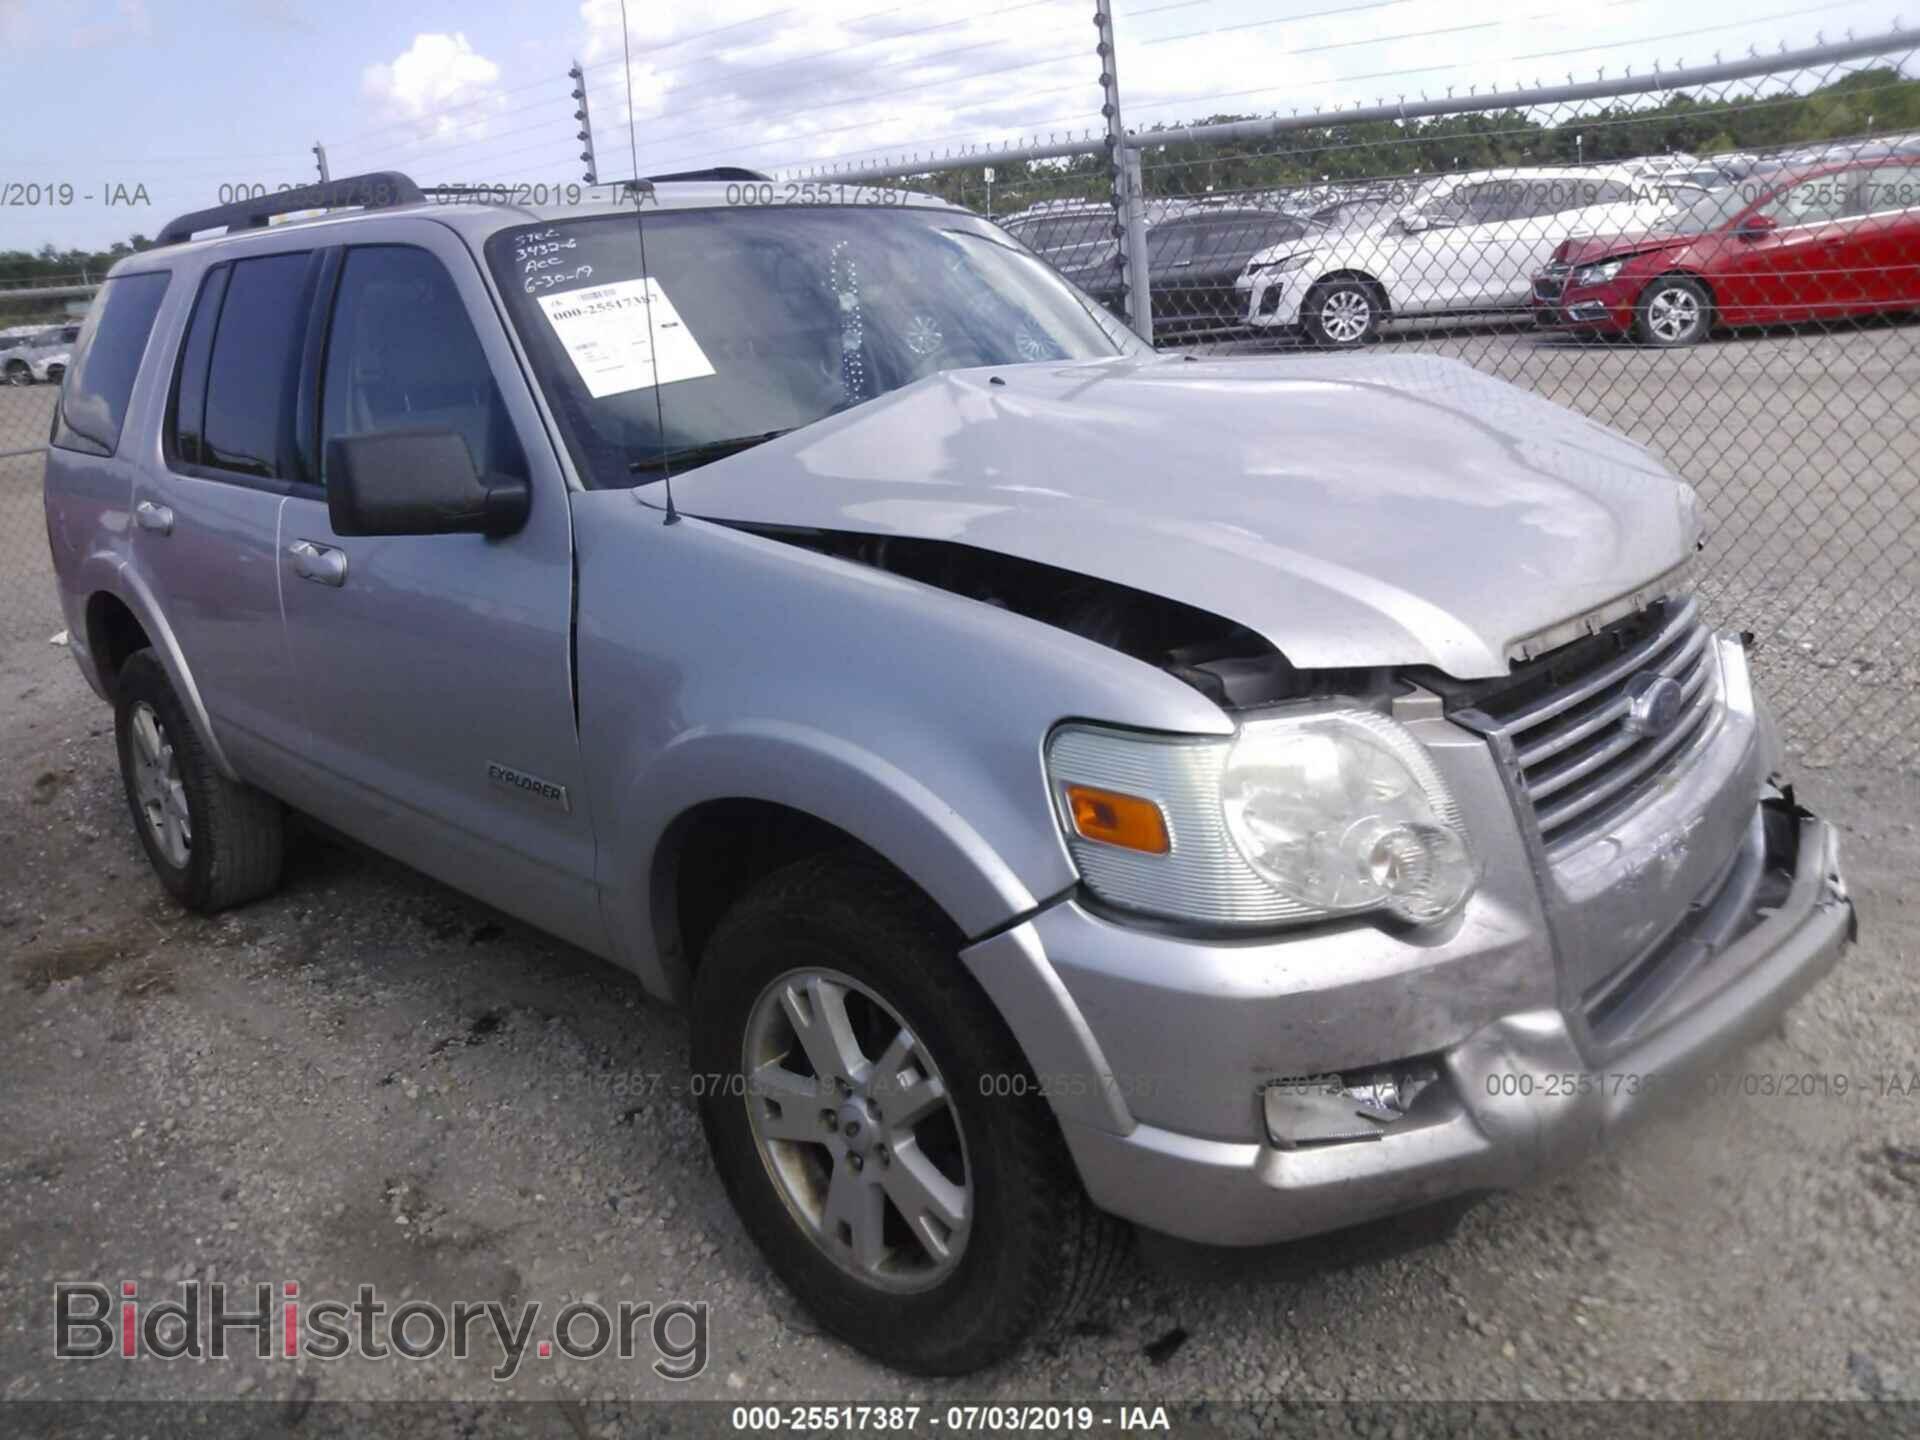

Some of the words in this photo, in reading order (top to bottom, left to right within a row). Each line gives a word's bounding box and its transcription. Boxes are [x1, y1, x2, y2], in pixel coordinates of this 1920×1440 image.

[524, 265, 593, 293] 6-30-19
[552, 294, 659, 322] 000-25517387
[488, 765, 561, 800] EXPLORER
